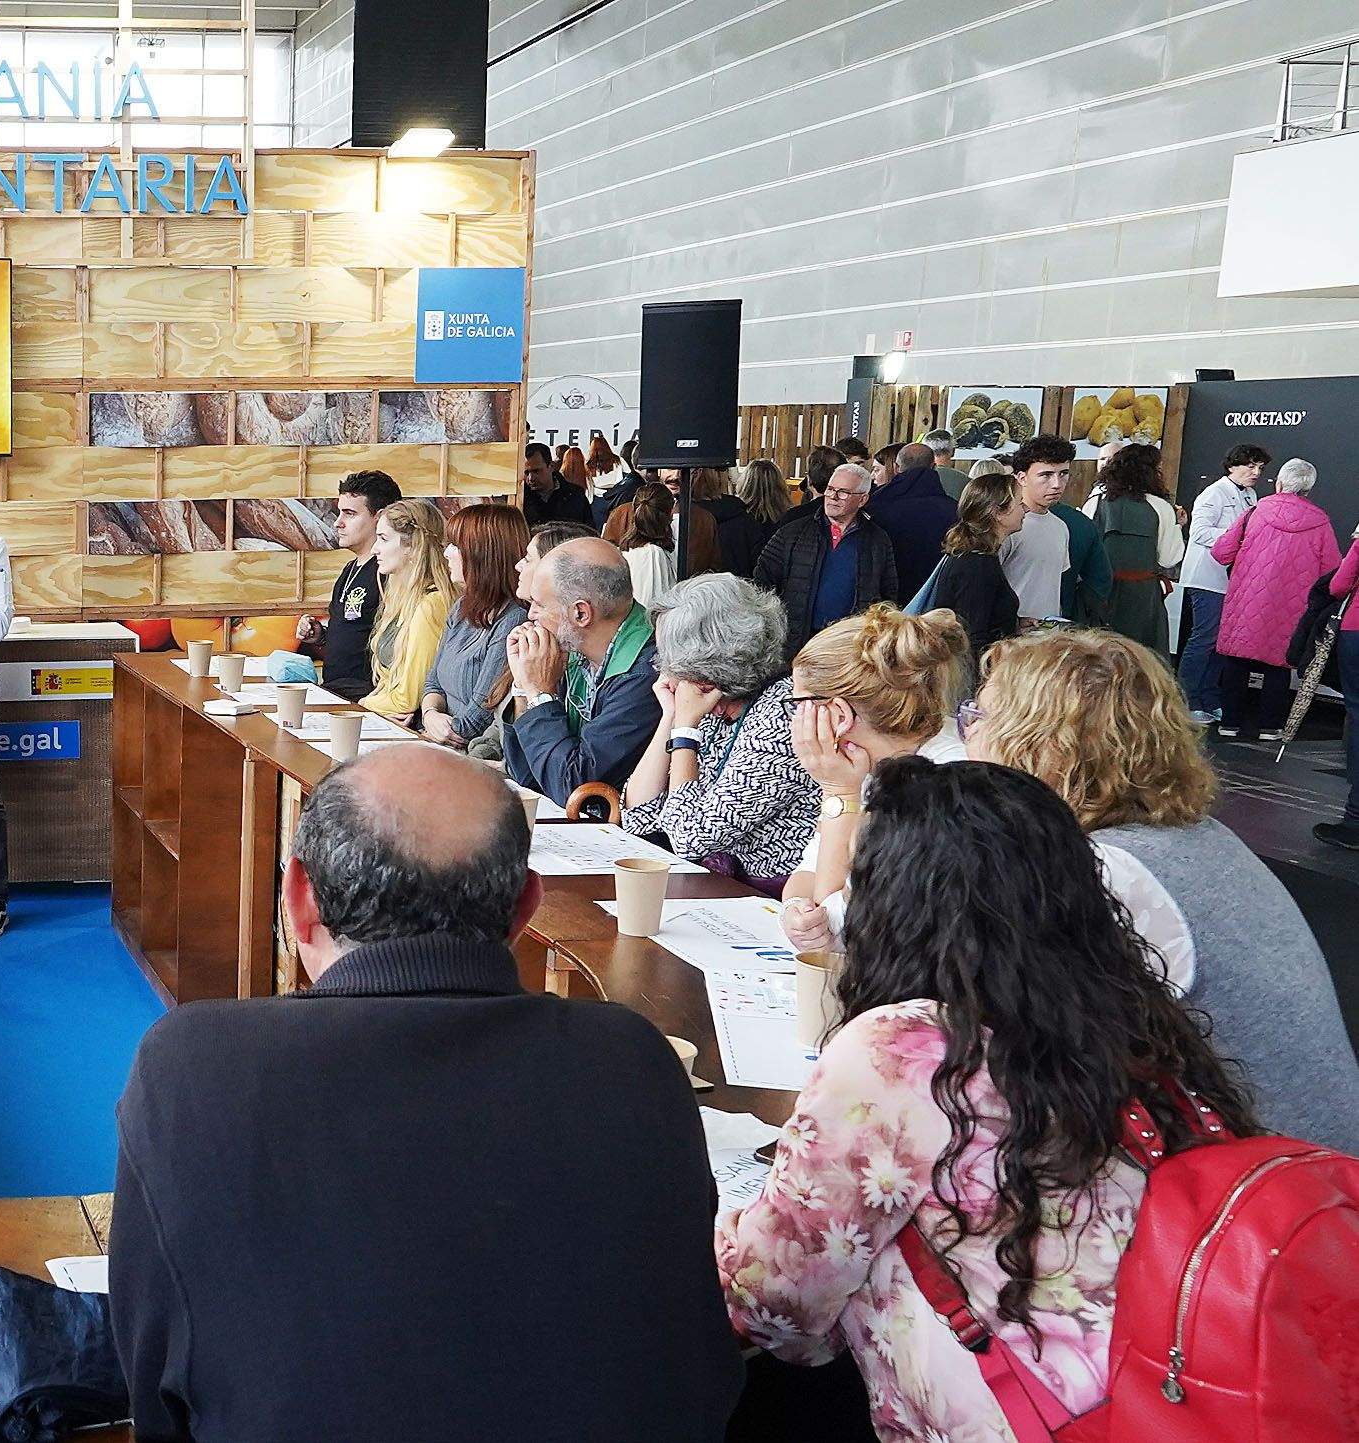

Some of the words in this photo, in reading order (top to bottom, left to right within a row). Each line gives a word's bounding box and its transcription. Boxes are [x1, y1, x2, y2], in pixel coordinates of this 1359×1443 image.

[447, 313, 490, 325] XUNTA
[447, 326, 464, 338] DE
[466, 326, 516, 338] GALICIA
